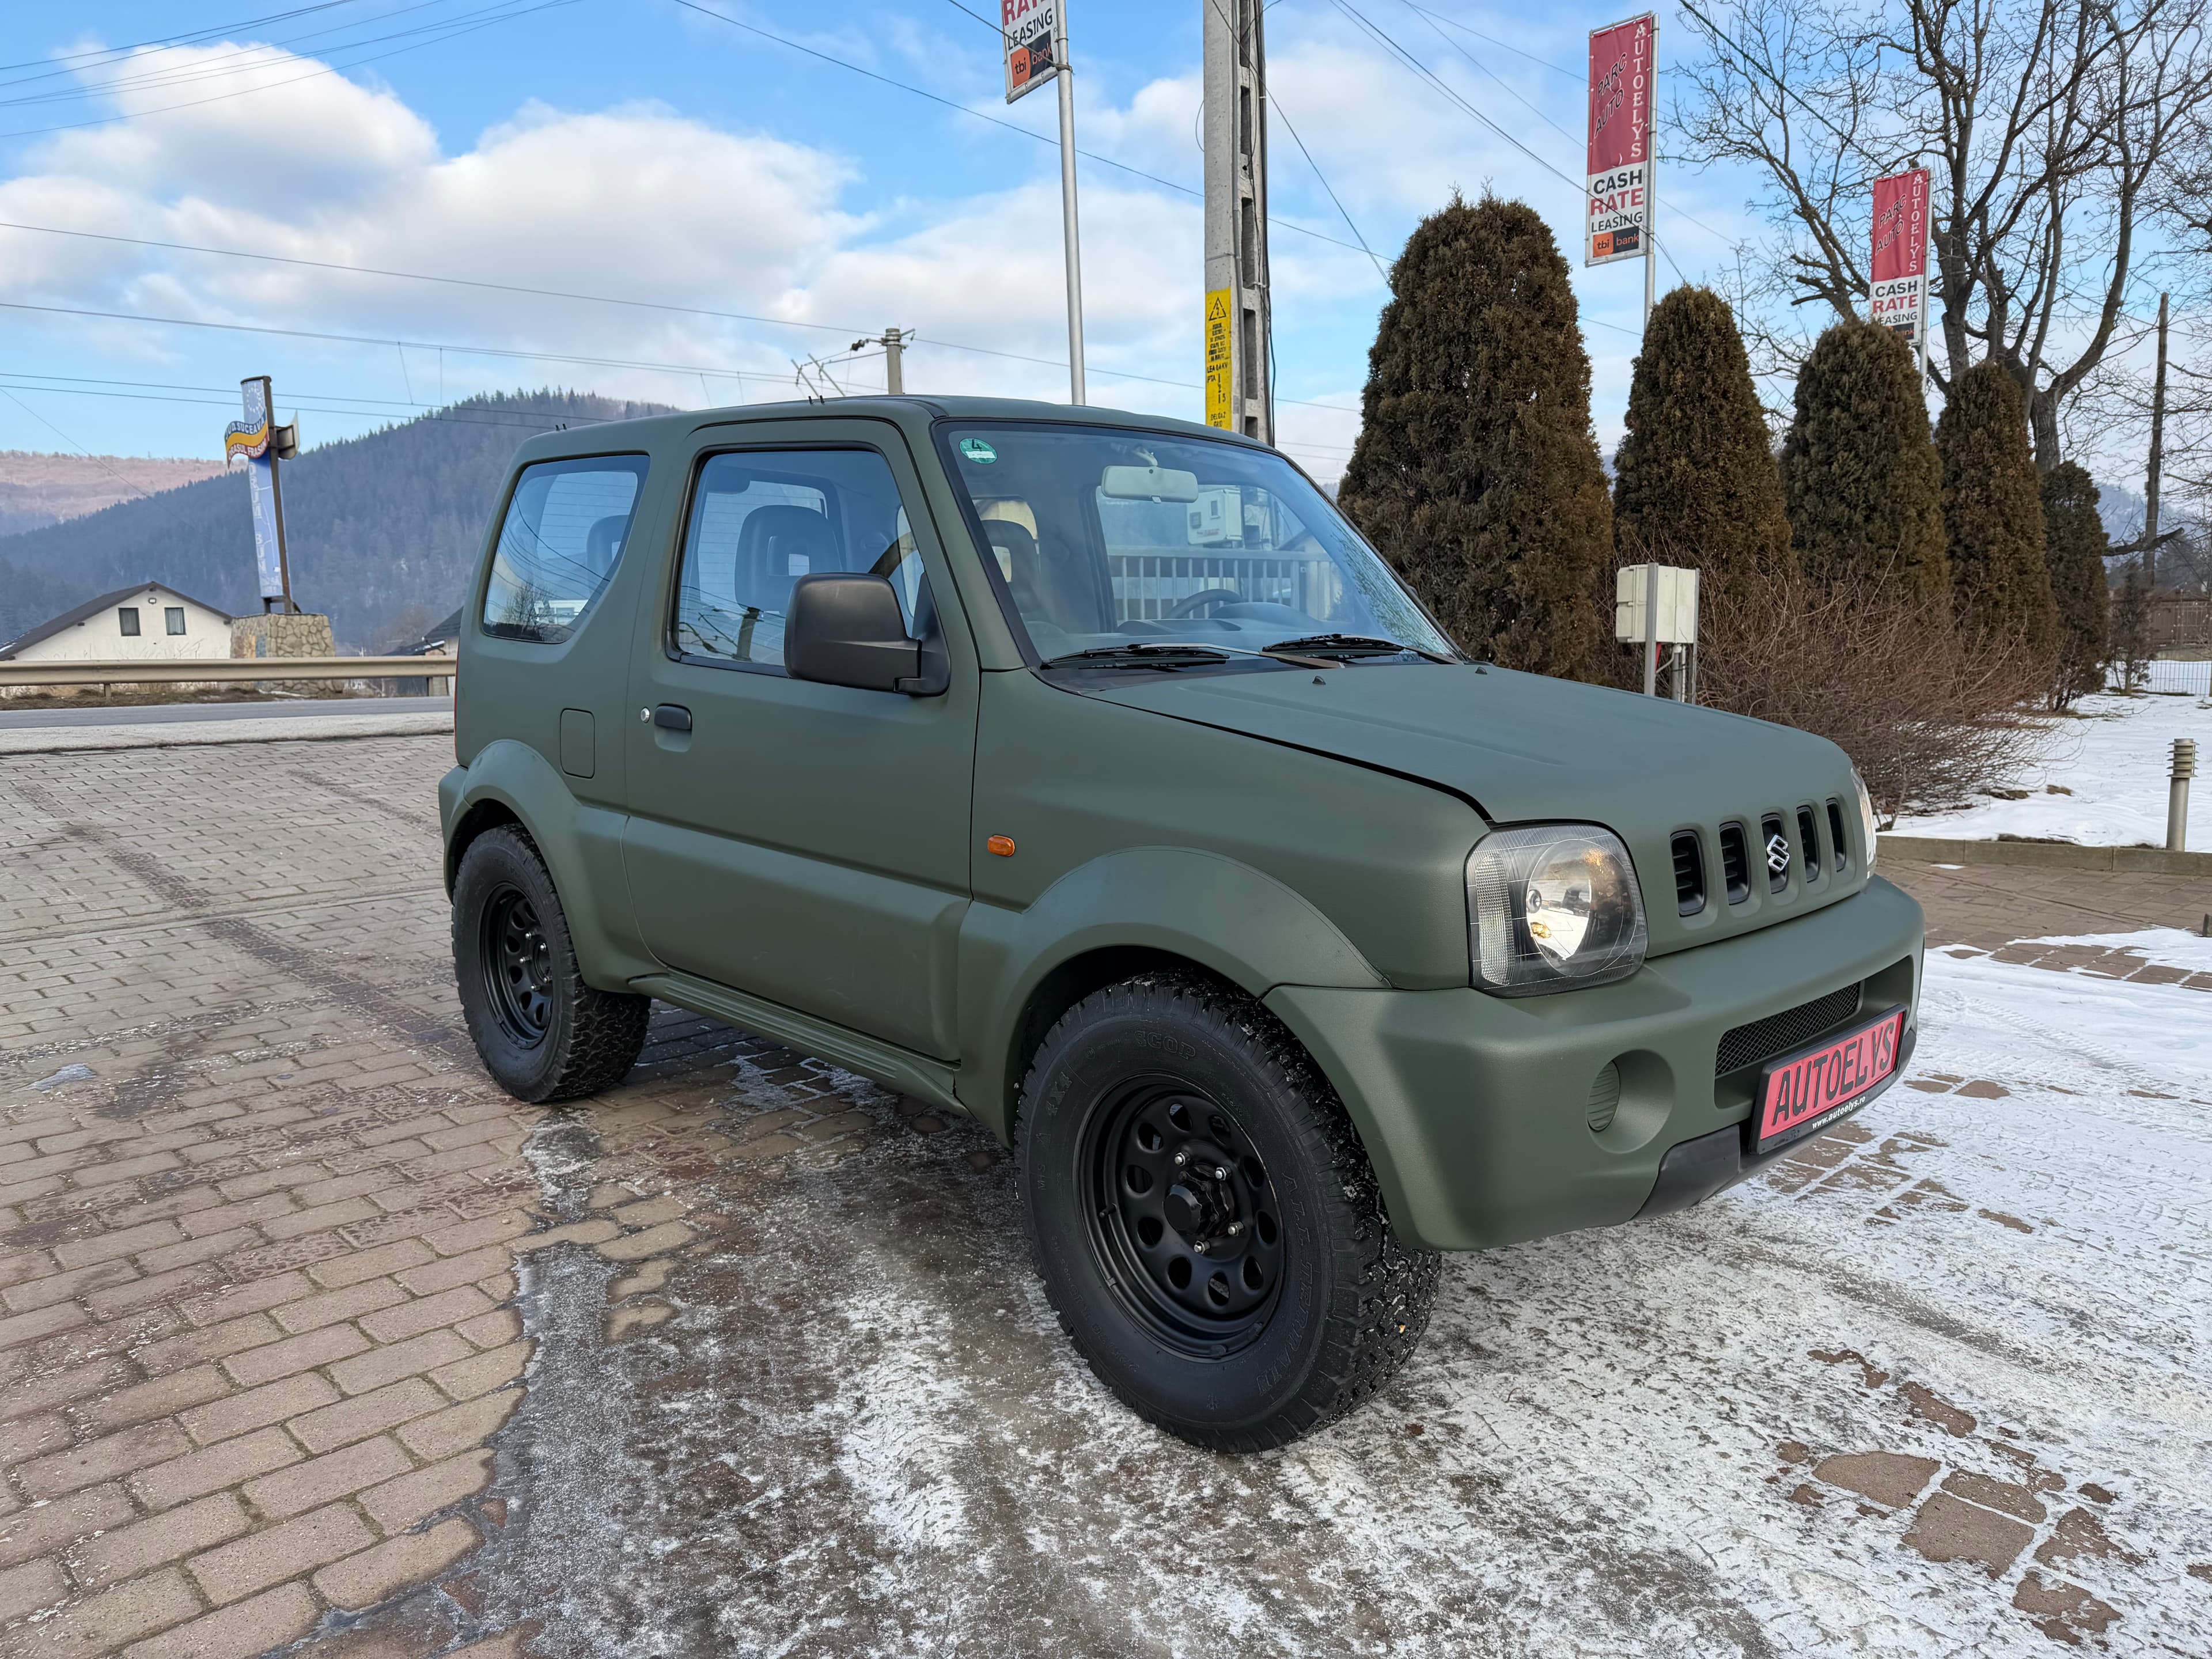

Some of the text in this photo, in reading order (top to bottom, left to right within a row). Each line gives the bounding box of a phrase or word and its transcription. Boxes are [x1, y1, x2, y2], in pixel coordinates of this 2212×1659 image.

[1003, 0, 1045, 26] RA
[1008, 8, 1053, 51] LEASING
[1015, 43, 1052, 74] tbi bank
[1597, 52, 1627, 103] PARC
[1631, 23, 1646, 157] AUTOELYS
[1594, 88, 1624, 139] AUTO
[1593, 169, 1642, 194] CASH
[1590, 187, 1643, 216] RATE
[1879, 194, 1907, 229] PARC
[1591, 211, 1643, 233] LEASING
[1909, 173, 1923, 272] AUTOELYS
[1597, 233, 1639, 249] tbi bank
[1875, 221, 1904, 256] AUTO
[1872, 294, 1918, 313] RATE
[1875, 280, 1918, 298] CASH
[1880, 312, 1918, 325] EASING
[237, 416, 265, 434] SUCEAVA
[972, 439, 982, 452] 4
[1772, 1021, 1894, 1126] AUTOELYS
[1812, 1096, 1866, 1130] www.autoelys.ro
